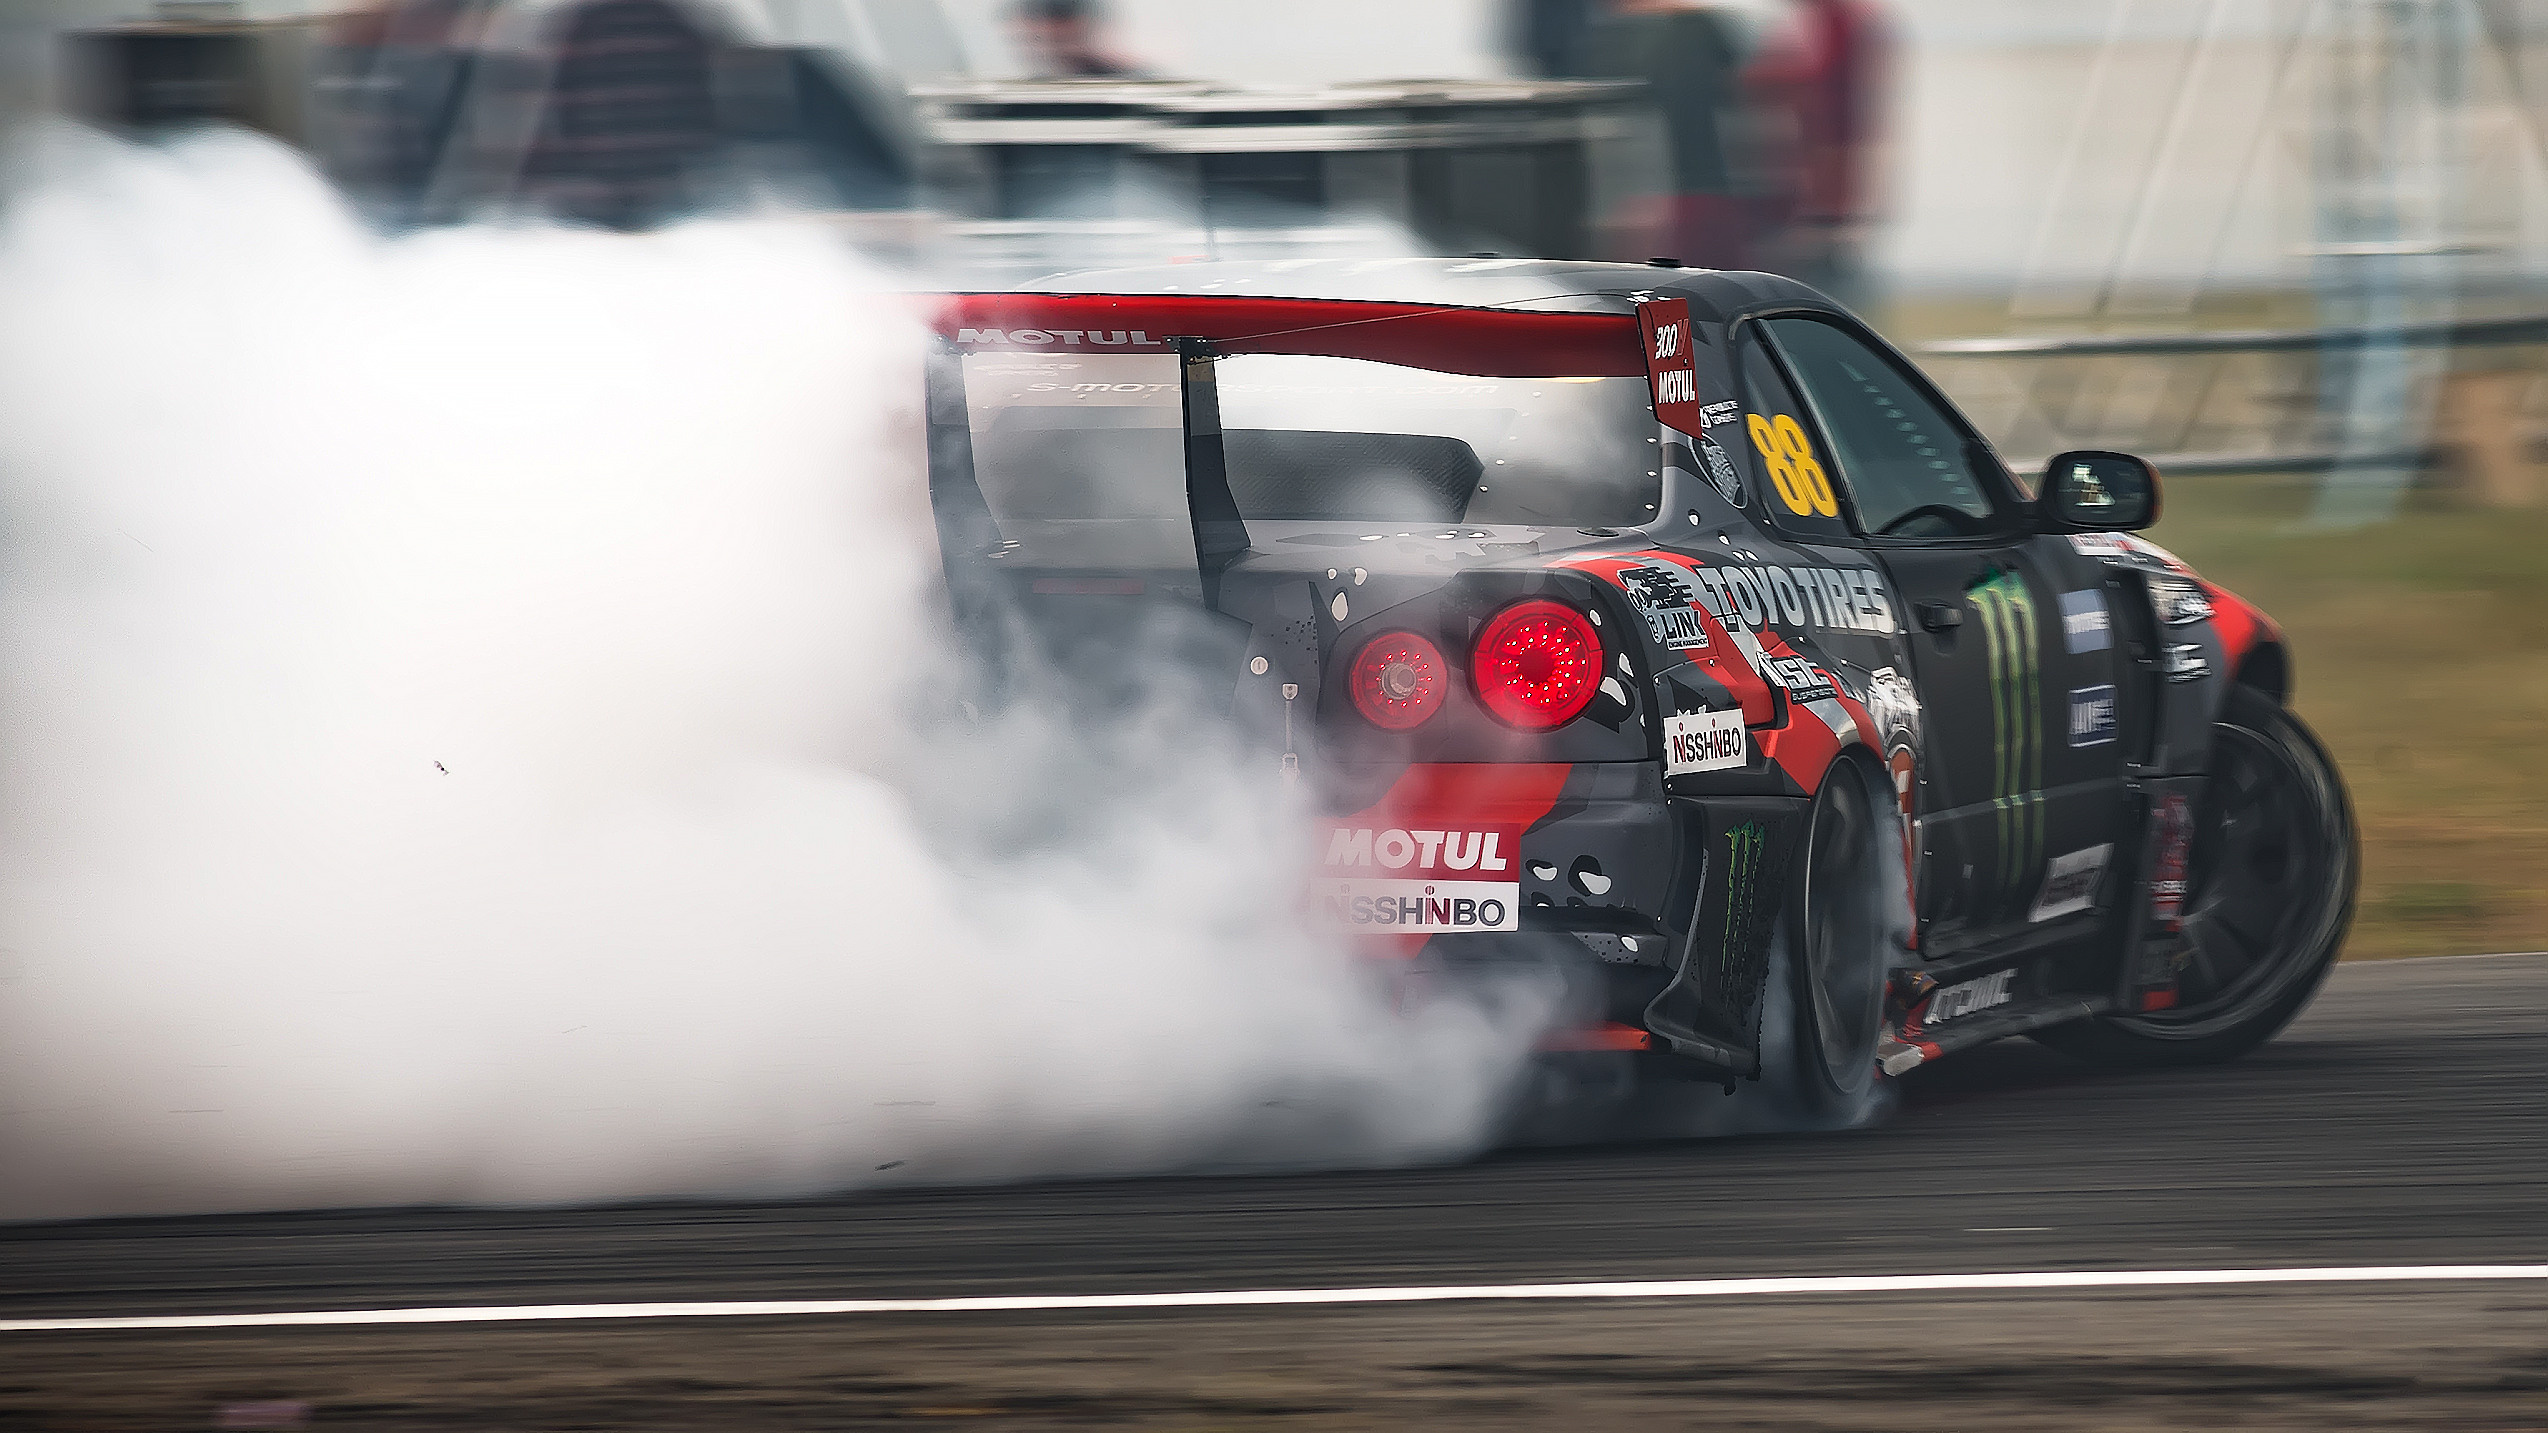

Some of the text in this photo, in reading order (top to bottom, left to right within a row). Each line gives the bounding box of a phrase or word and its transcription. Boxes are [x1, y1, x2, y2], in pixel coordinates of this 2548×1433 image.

[957, 328, 1162, 346] MOTUL
[1659, 369, 1696, 404] MOTUL
[1745, 413, 1839, 518] 88
[1697, 566, 1805, 629] TOYO
[1789, 566, 1895, 634] TIRES
[1660, 611, 1706, 639] LINK
[1324, 828, 1508, 871] MOTUL
